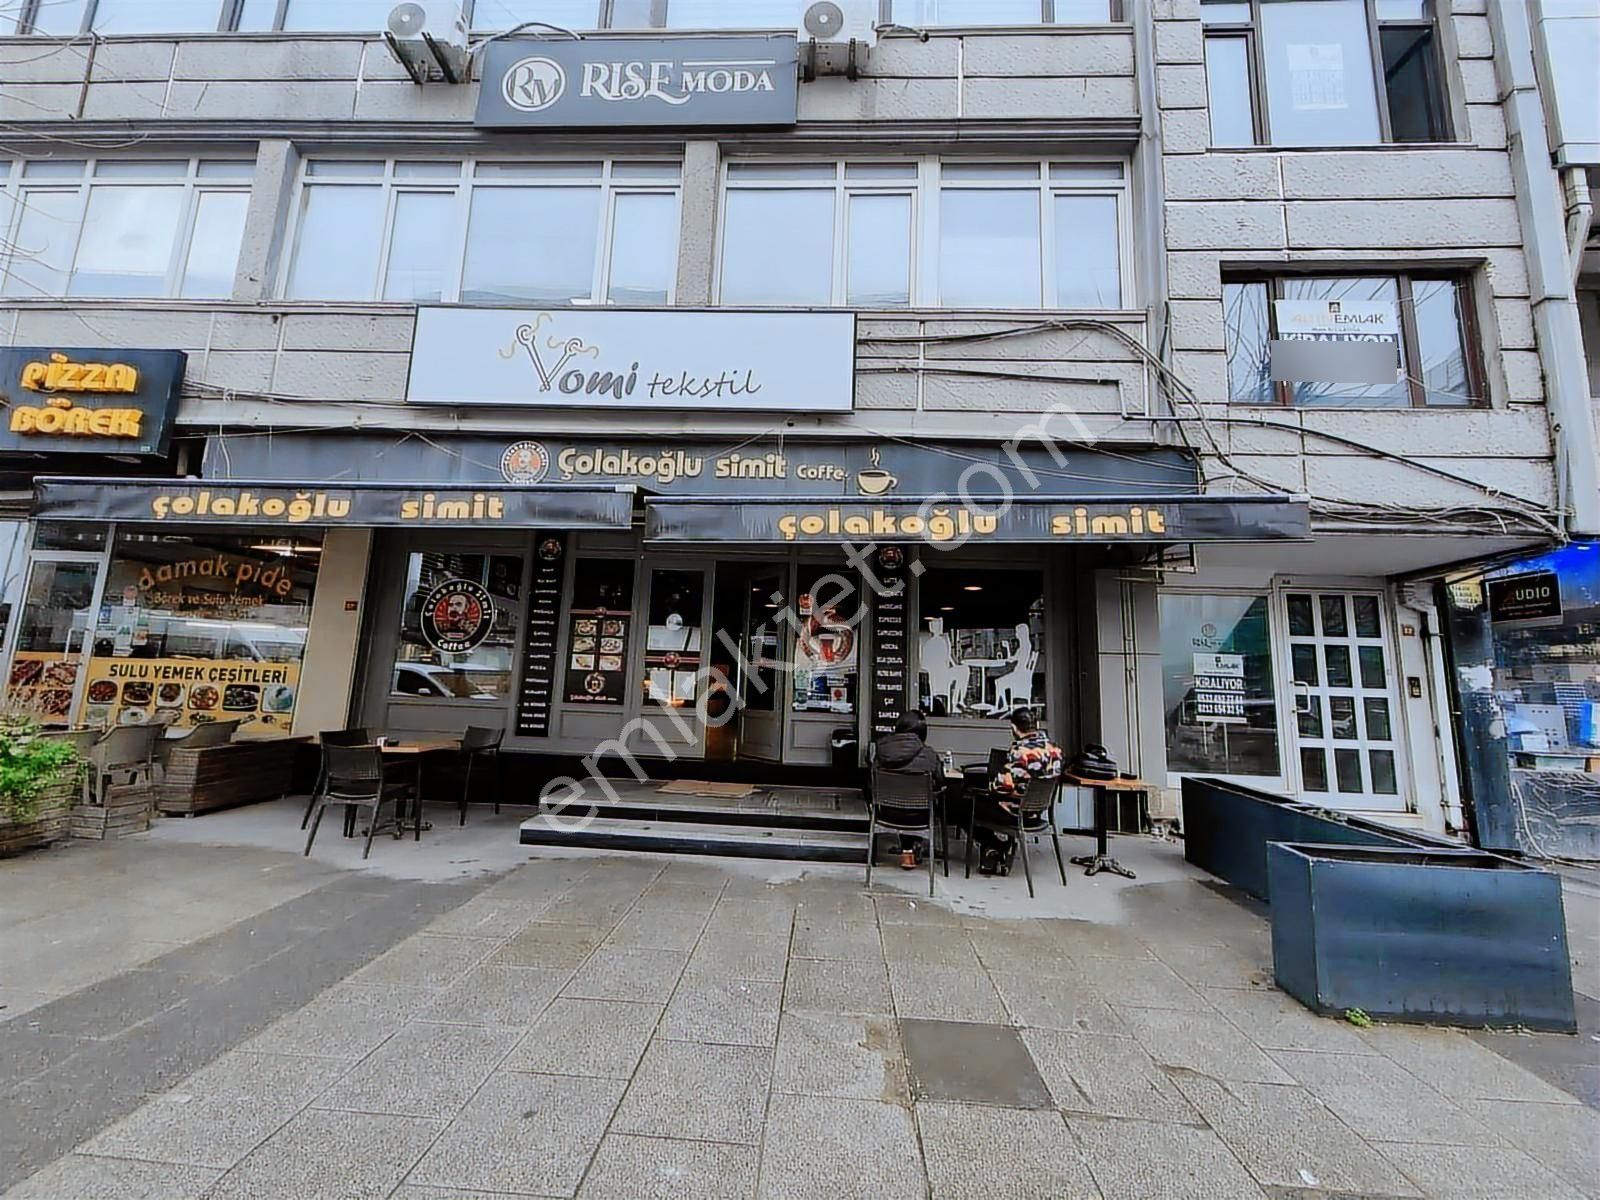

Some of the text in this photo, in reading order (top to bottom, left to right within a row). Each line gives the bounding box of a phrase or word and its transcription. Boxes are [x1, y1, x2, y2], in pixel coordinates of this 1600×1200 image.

[580, 61, 776, 105] RISE MODA
[1334, 313, 1384, 325] EMLAK
[21, 352, 138, 393] PİZZA
[647, 369, 763, 399] tekstil
[10, 397, 144, 437] BÖREK
[557, 447, 704, 484] Çolakoğlu
[715, 448, 787, 479] simit
[152, 491, 505, 523] çolakoğlu simit
[777, 505, 1167, 540] çolakoğlu simit
[138, 554, 292, 596] damak pide
[109, 664, 288, 684] SULU YEMEK ÇEŞİTLERİ
